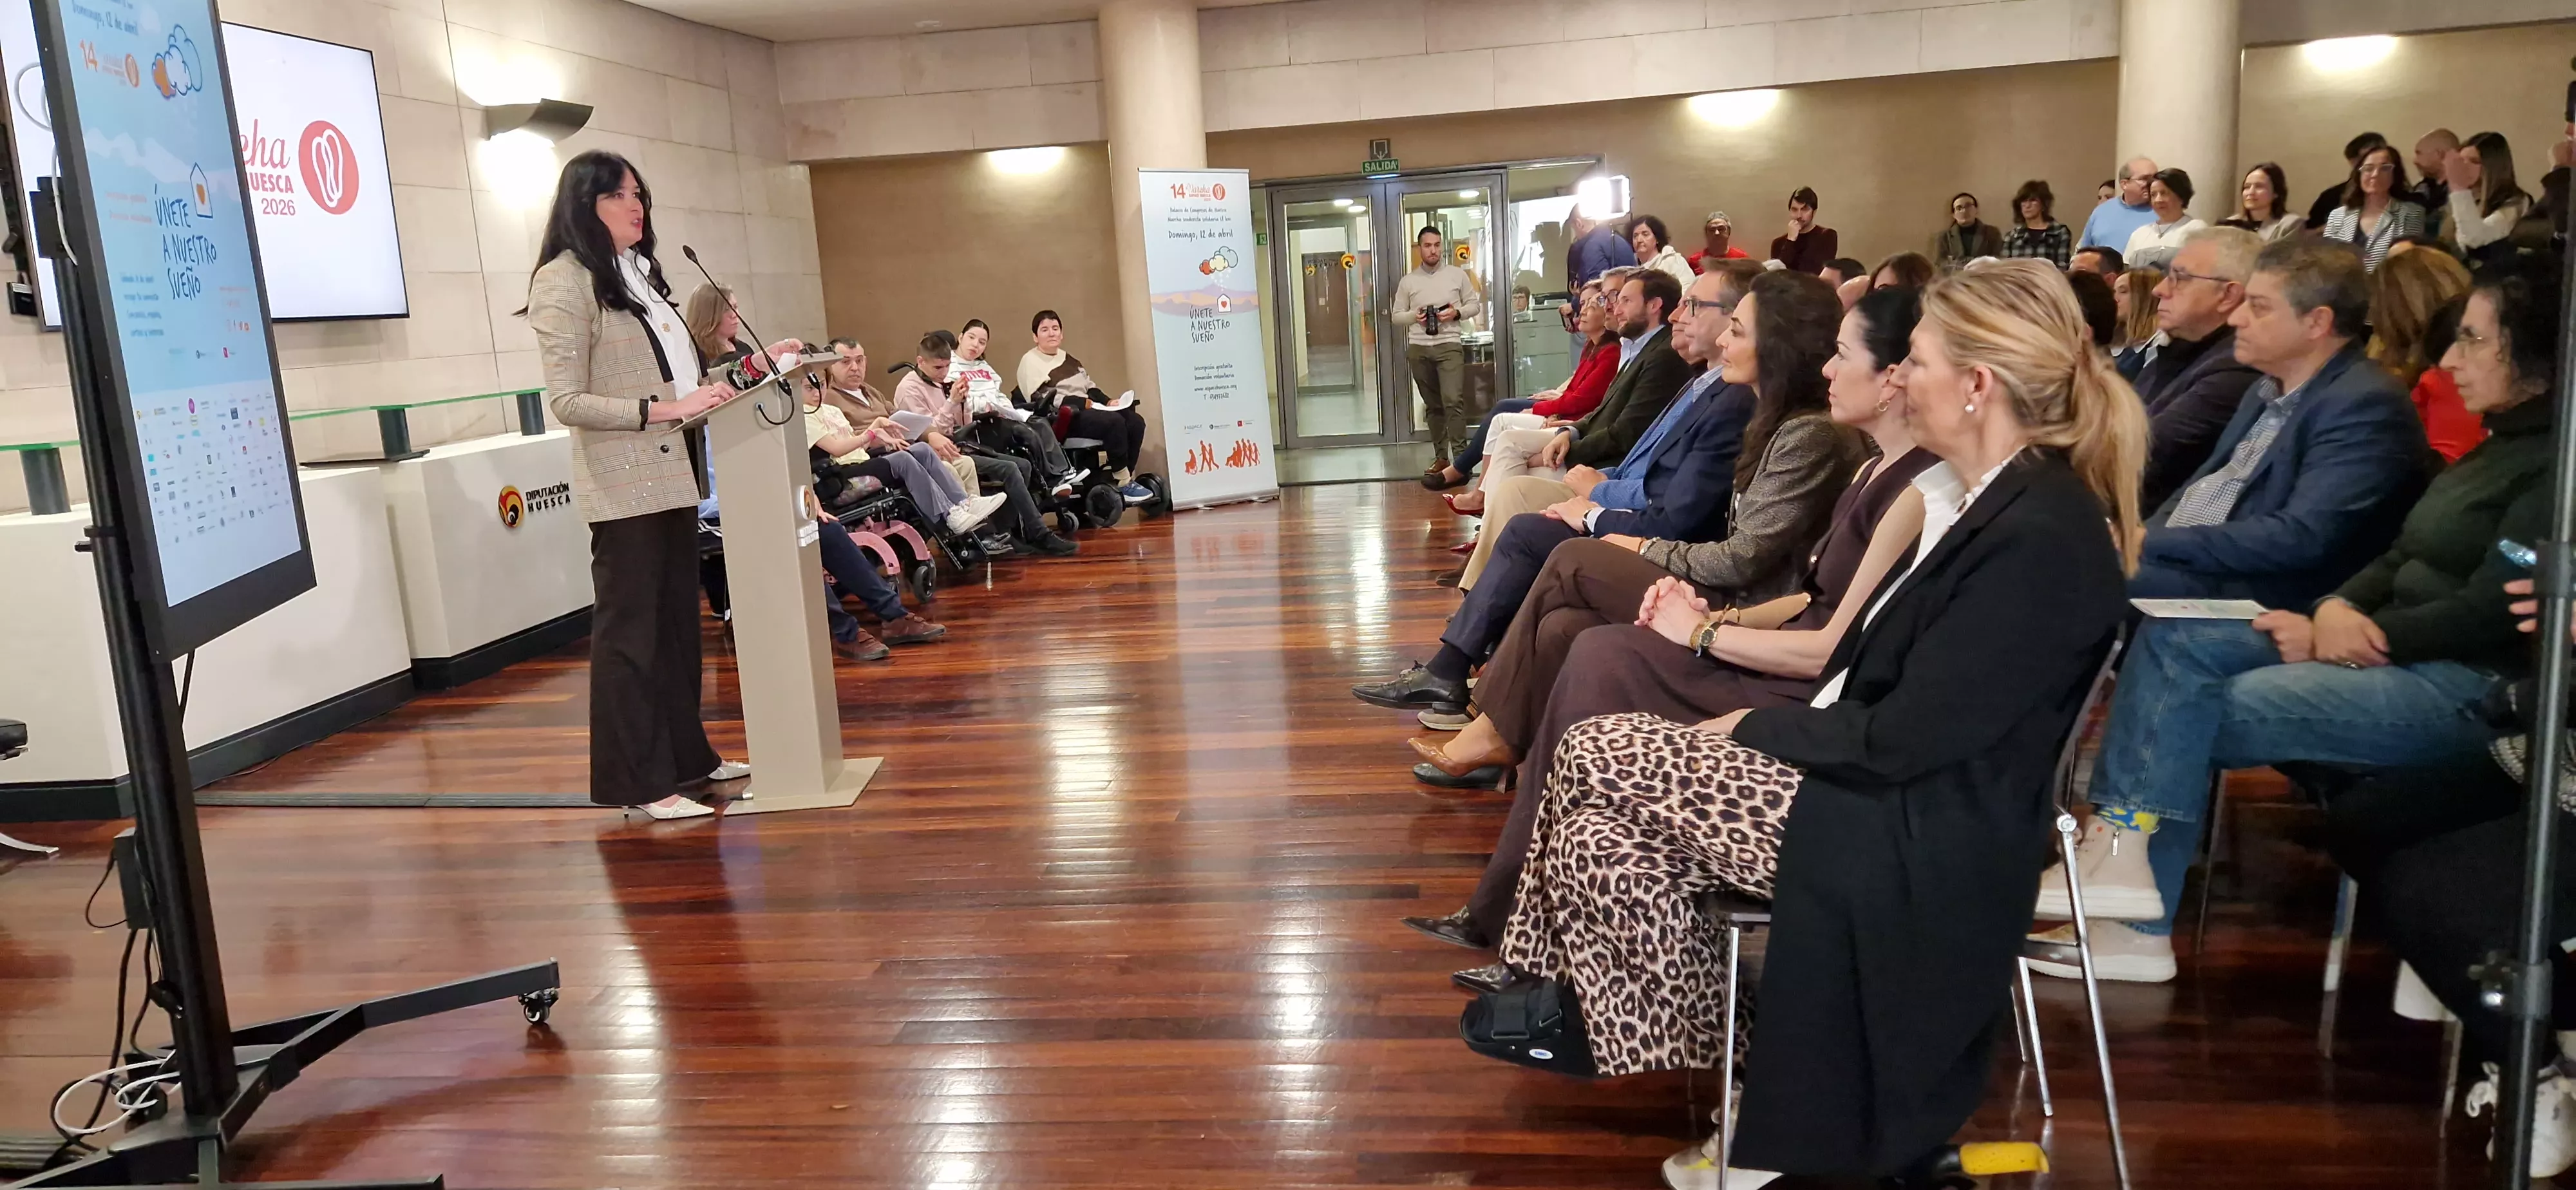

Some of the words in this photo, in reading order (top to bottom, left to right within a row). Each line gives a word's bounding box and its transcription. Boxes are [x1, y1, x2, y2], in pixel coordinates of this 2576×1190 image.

[79, 39, 98, 72] 14
[1364, 160, 1397, 172] SALIDA
[249, 172, 295, 194] UESCA
[1170, 183, 1186, 199] 14
[155, 183, 191, 228] ÚNETE
[261, 198, 296, 216] 2026
[1168, 229, 1198, 243] Domingo,
[1200, 229, 1206, 239] 12
[1208, 229, 1216, 238] de
[1218, 228, 1233, 238] abril
[163, 233, 171, 263] A
[171, 233, 217, 265] NUESTRO
[167, 265, 201, 301] SUEÑO
[1189, 305, 1213, 320] ÚNETE
[1191, 321, 1196, 332] A
[1198, 319, 1231, 332] NUESTRO
[1191, 330, 1215, 344] SUEÑO
[526, 481, 570, 502] DIPUTACIÓN
[527, 494, 571, 513] HUESCA
